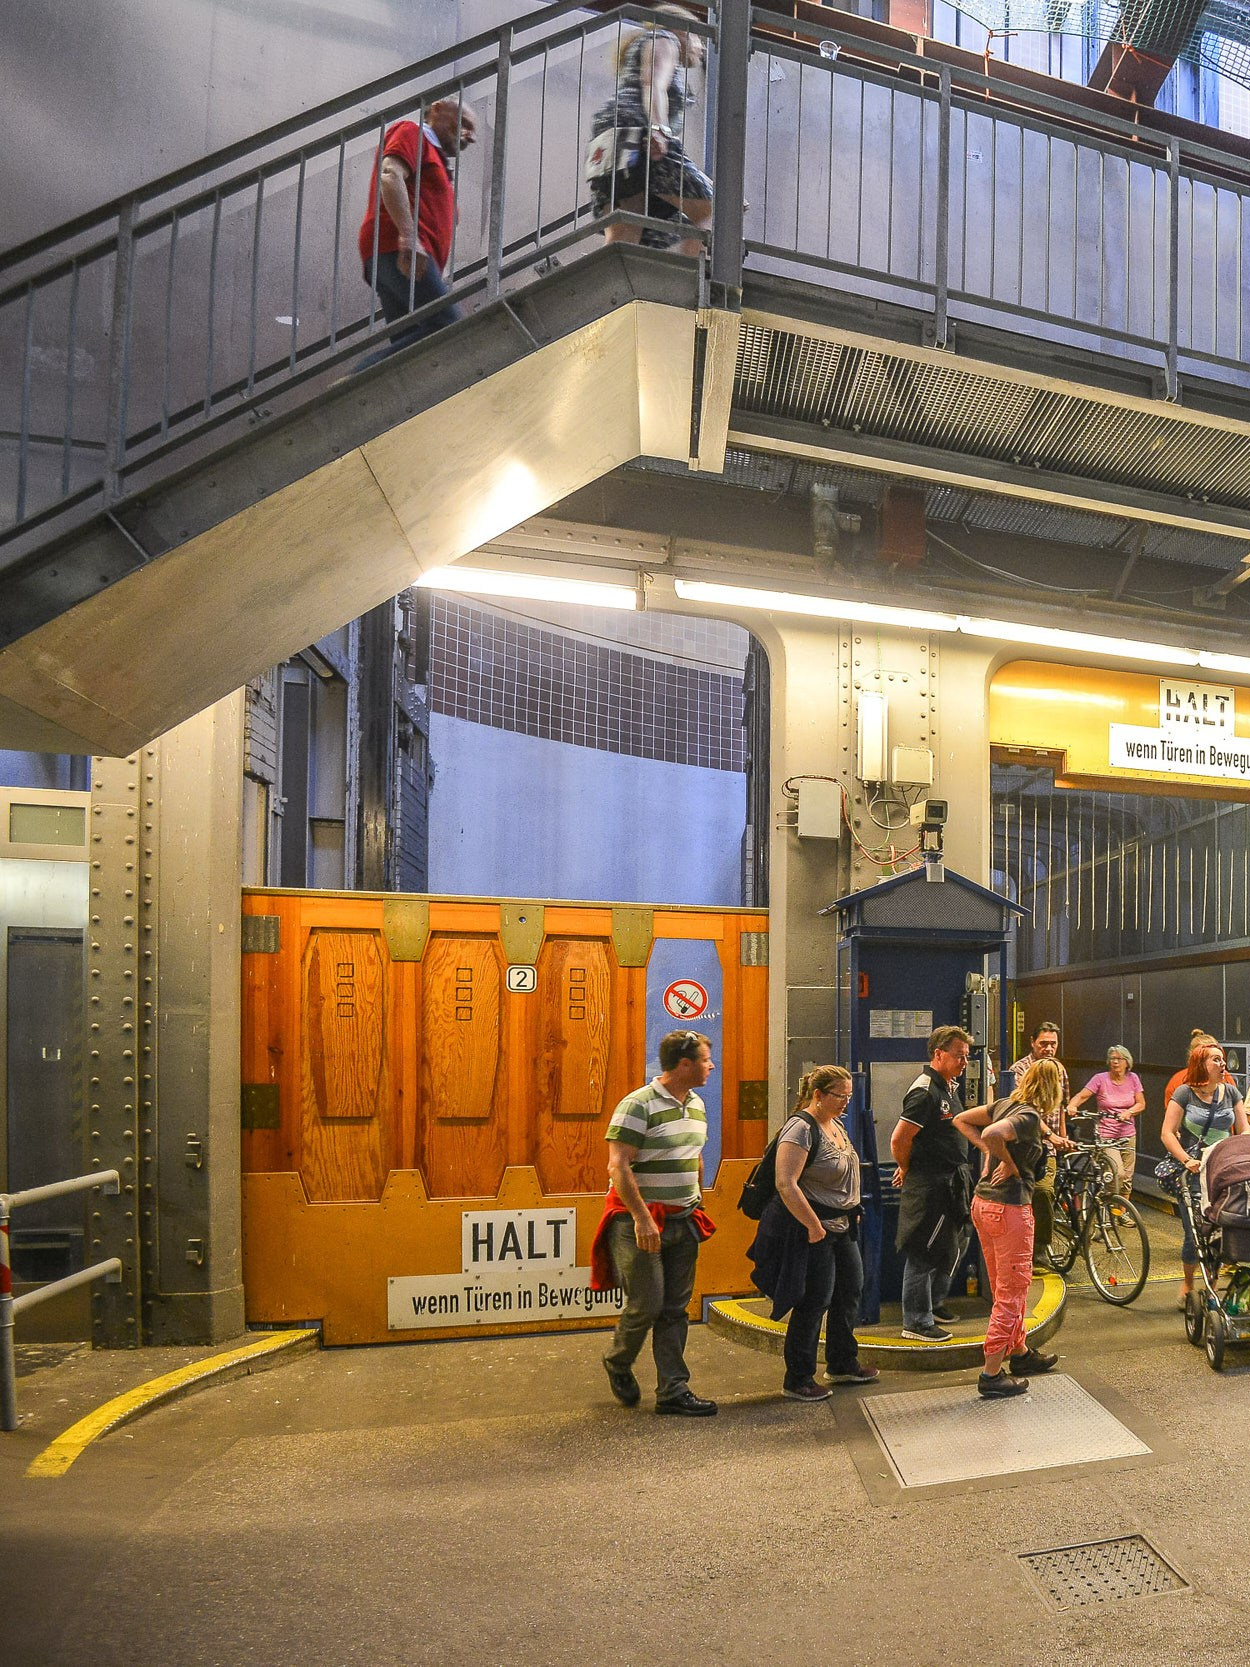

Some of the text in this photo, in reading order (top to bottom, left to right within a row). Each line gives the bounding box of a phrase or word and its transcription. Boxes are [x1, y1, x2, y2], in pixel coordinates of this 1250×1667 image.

[1166, 689, 1230, 727] HALT
[1125, 741, 1157, 760] wenn
[1160, 740, 1192, 763] Türen
[1195, 743, 1205, 765] in
[515, 970, 528, 988] 2
[472, 1219, 568, 1262] HALT
[412, 1282, 624, 1315] wenn Türen in Bewegung
